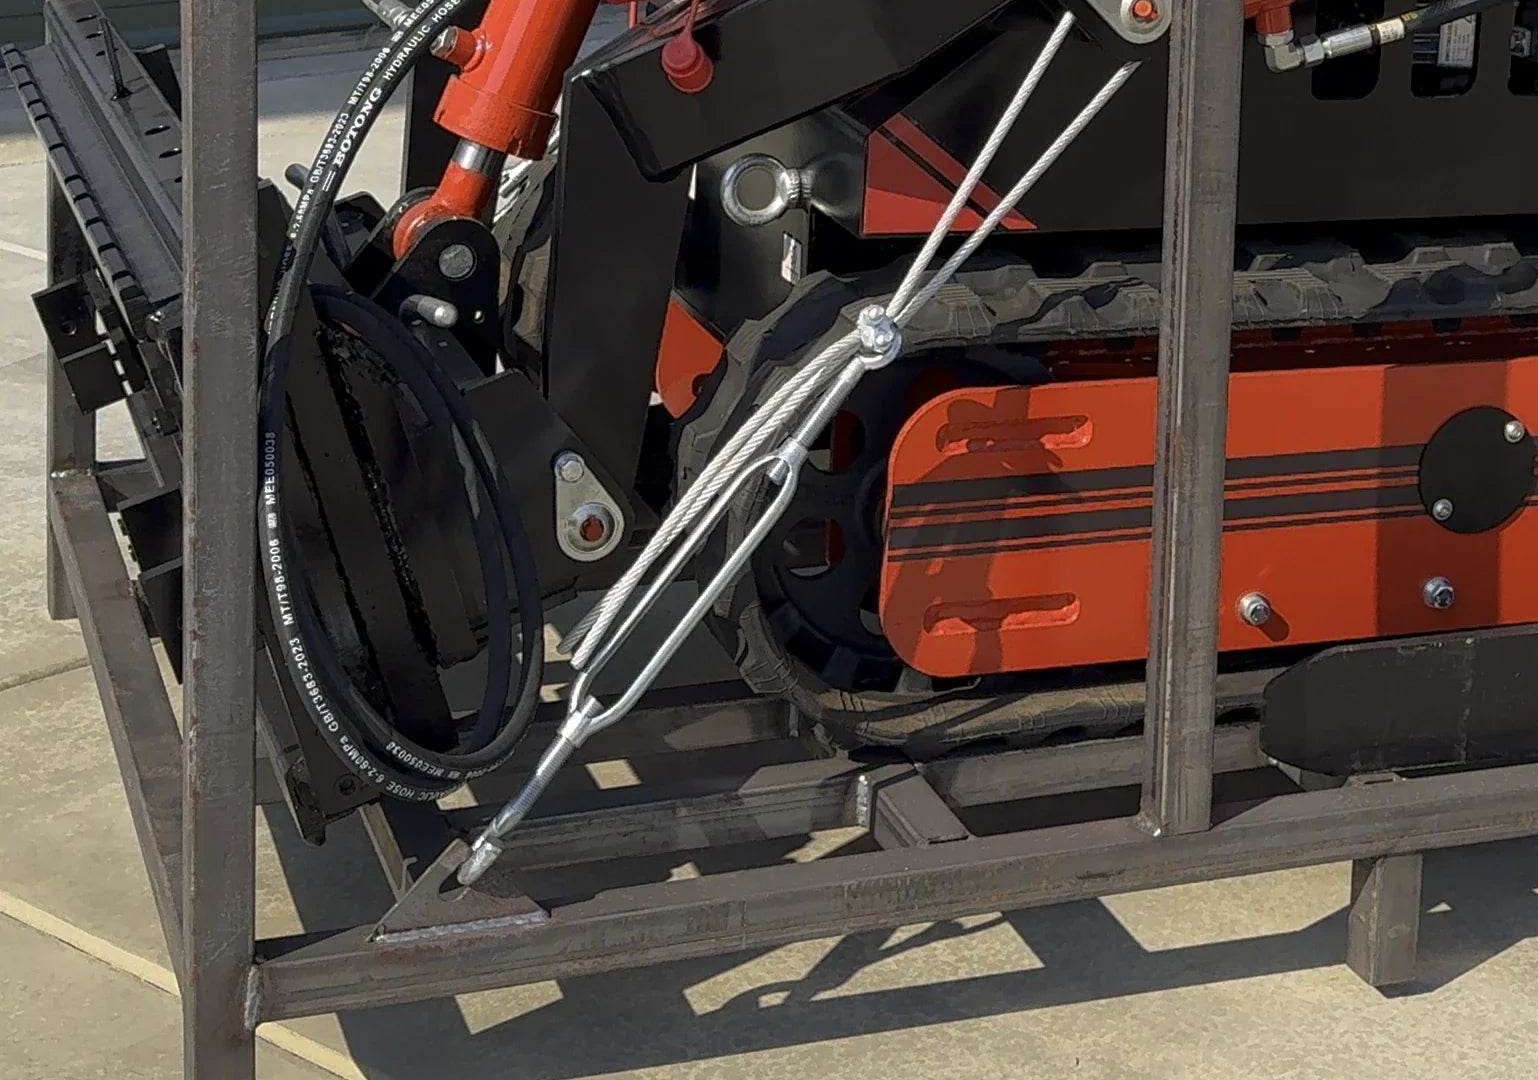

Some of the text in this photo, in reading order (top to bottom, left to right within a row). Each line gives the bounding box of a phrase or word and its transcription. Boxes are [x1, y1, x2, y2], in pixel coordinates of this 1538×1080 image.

[333, 86, 383, 168] BOTONG
[382, 24, 432, 81] HYDRAULIC
[264, 431, 277, 505] MEE050038
[268, 538, 295, 626] MT/T98-2006
[288, 637, 339, 732] GB/T3683-2023
[386, 780, 416, 798] HOSE
